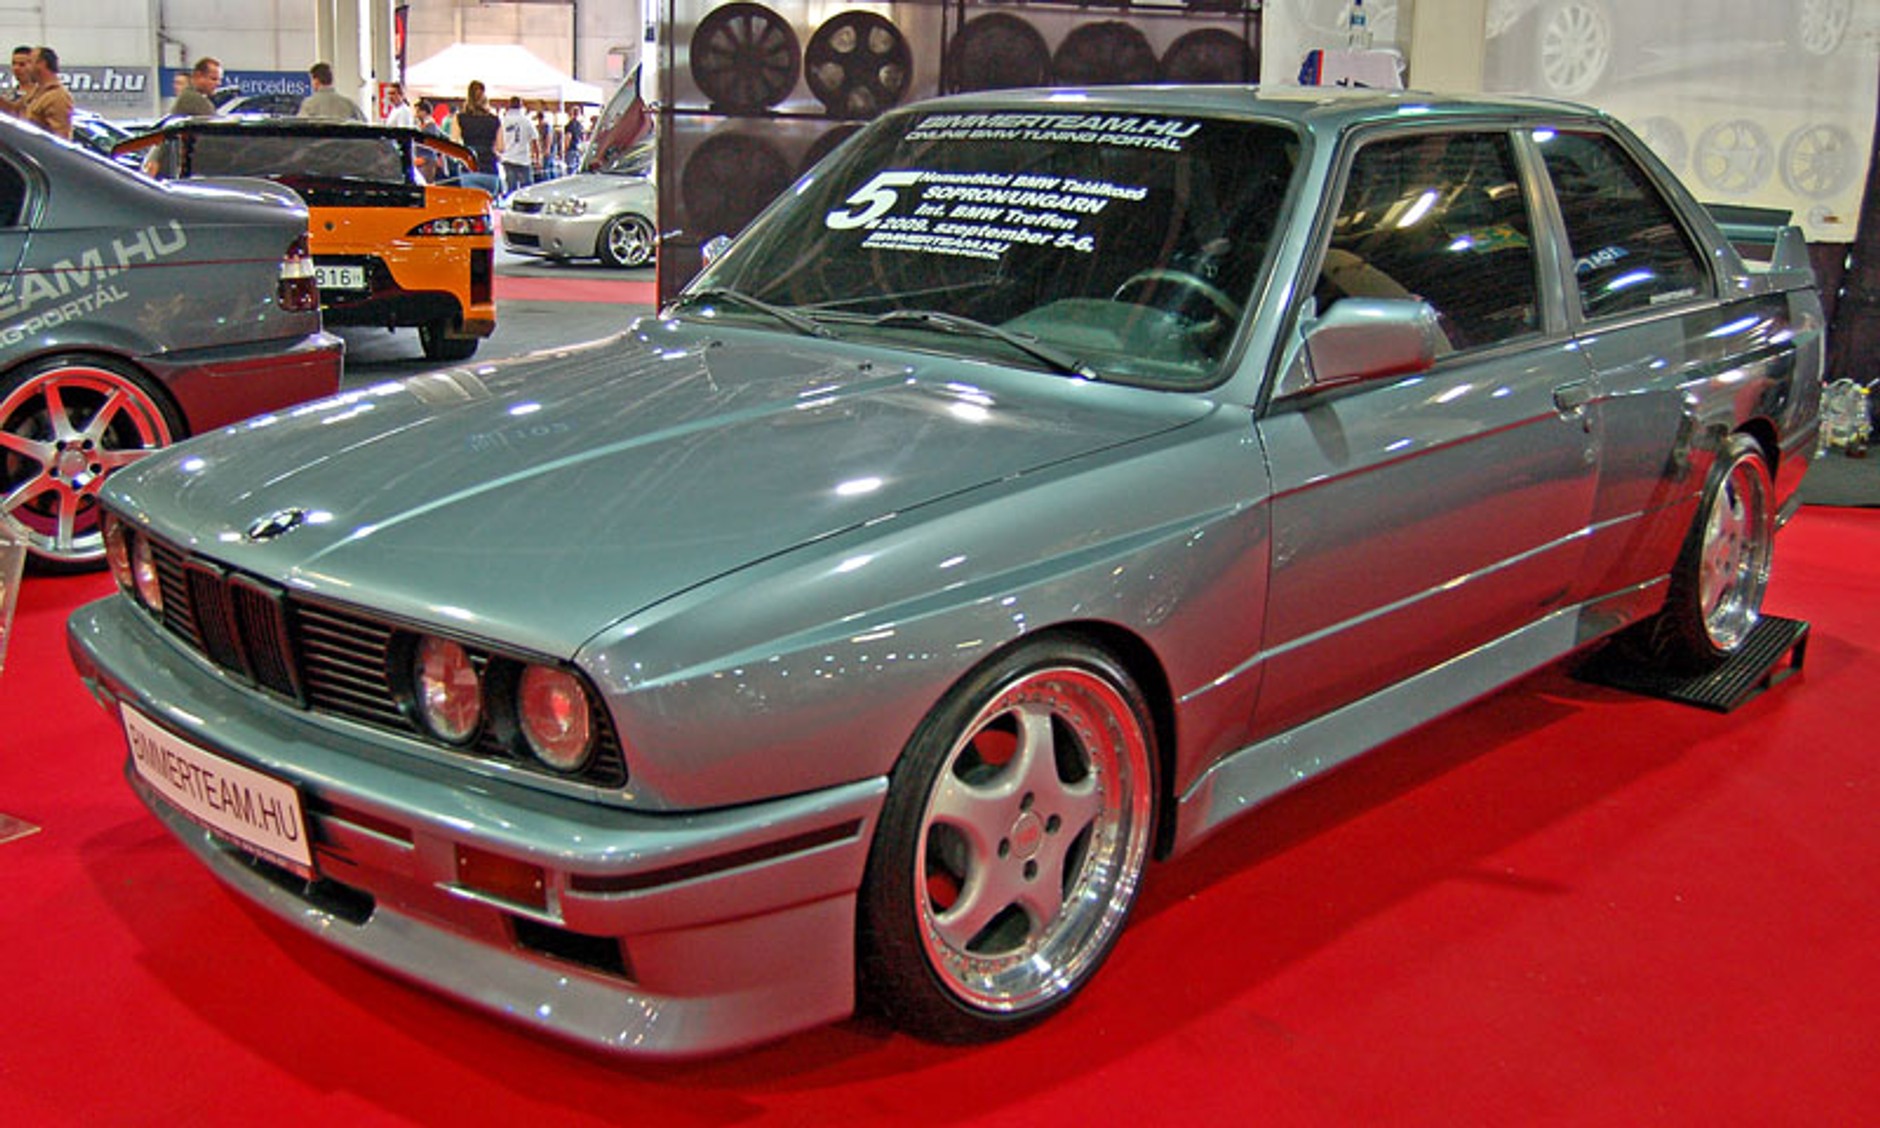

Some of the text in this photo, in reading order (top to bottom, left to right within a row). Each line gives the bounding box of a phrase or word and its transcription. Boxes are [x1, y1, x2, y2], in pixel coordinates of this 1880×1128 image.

[916, 114, 1201, 138] BIMMERTEAM.HU
[968, 129, 1021, 140] BMW
[1022, 130, 1097, 143] TUNING
[1011, 174, 1061, 190] BMW
[914, 202, 1079, 230] Int. BMW Treffen
[932, 222, 1054, 245] szeptember
[24, 283, 129, 335] PORTÁL
[129, 723, 298, 842] BIMMERTEAM.HU
